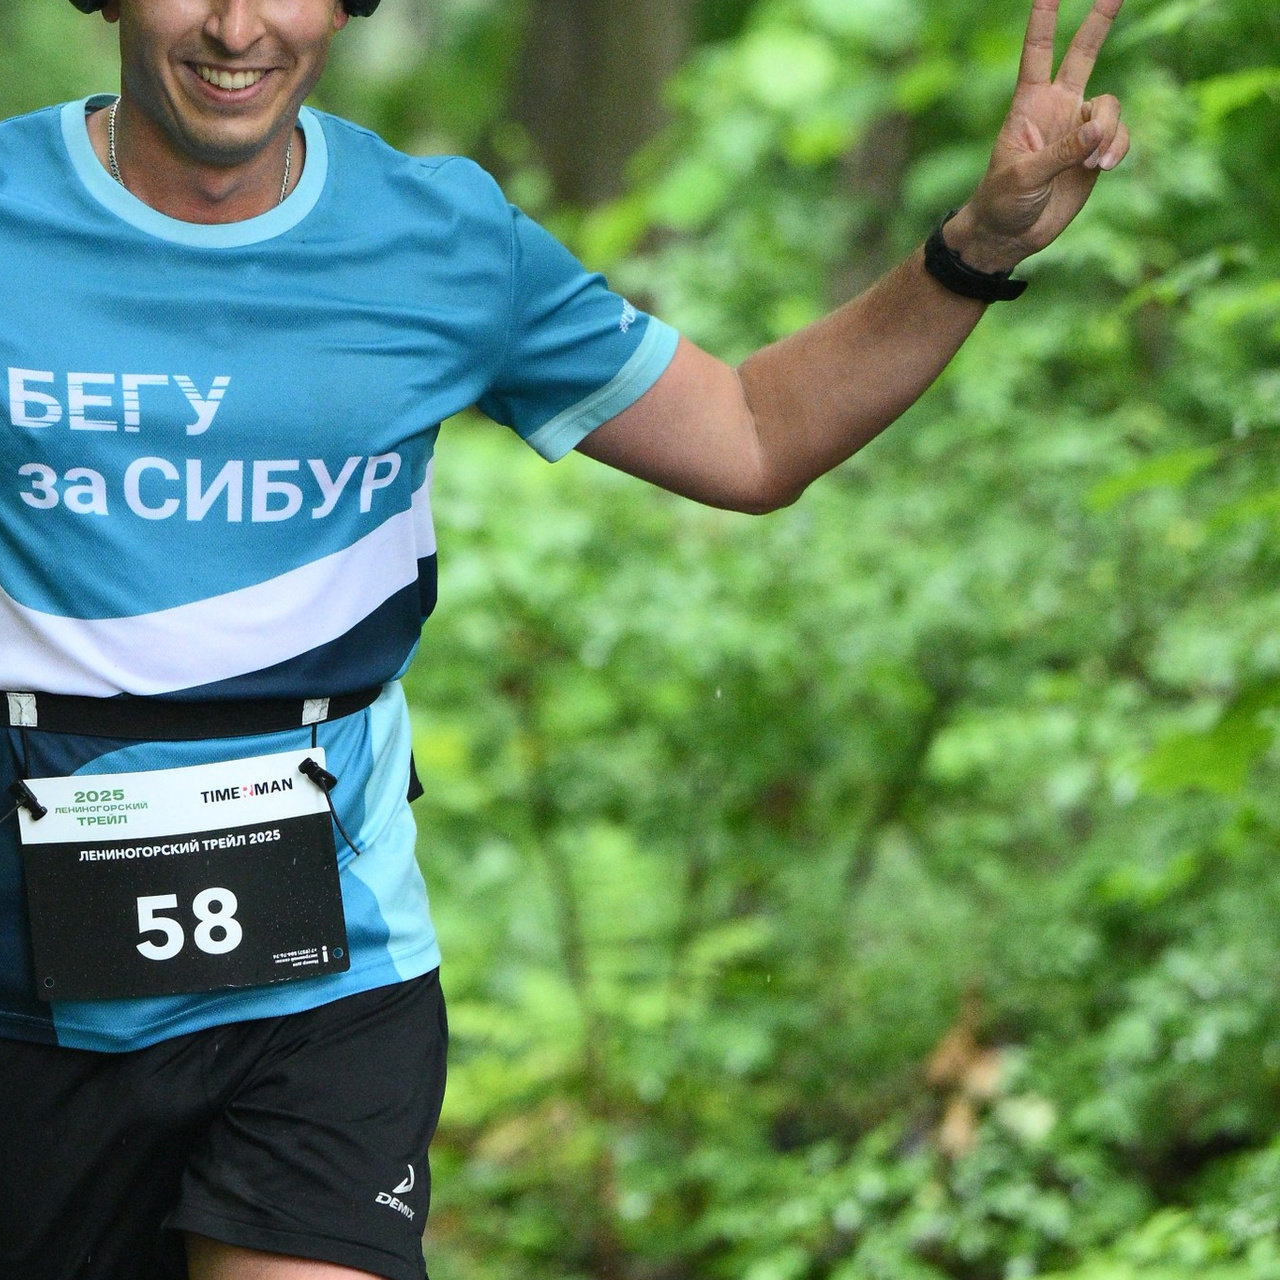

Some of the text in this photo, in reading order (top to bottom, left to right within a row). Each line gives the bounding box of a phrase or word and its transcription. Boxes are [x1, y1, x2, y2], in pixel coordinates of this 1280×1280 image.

[7, 367, 232, 436] БЕГУ
[18, 451, 402, 523] за СИБУР
[55, 801, 148, 814] ЛЕНИНОГОРСКИЙ
[73, 789, 125, 803] 2025
[76, 813, 128, 826] ТРЕЙЛ
[78, 829, 281, 861] ЛЕНИНОГОРСКИЙ ТРЕЙЛ 2025
[135, 887, 243, 961] 58
[375, 1192, 415, 1221] DEMIX
